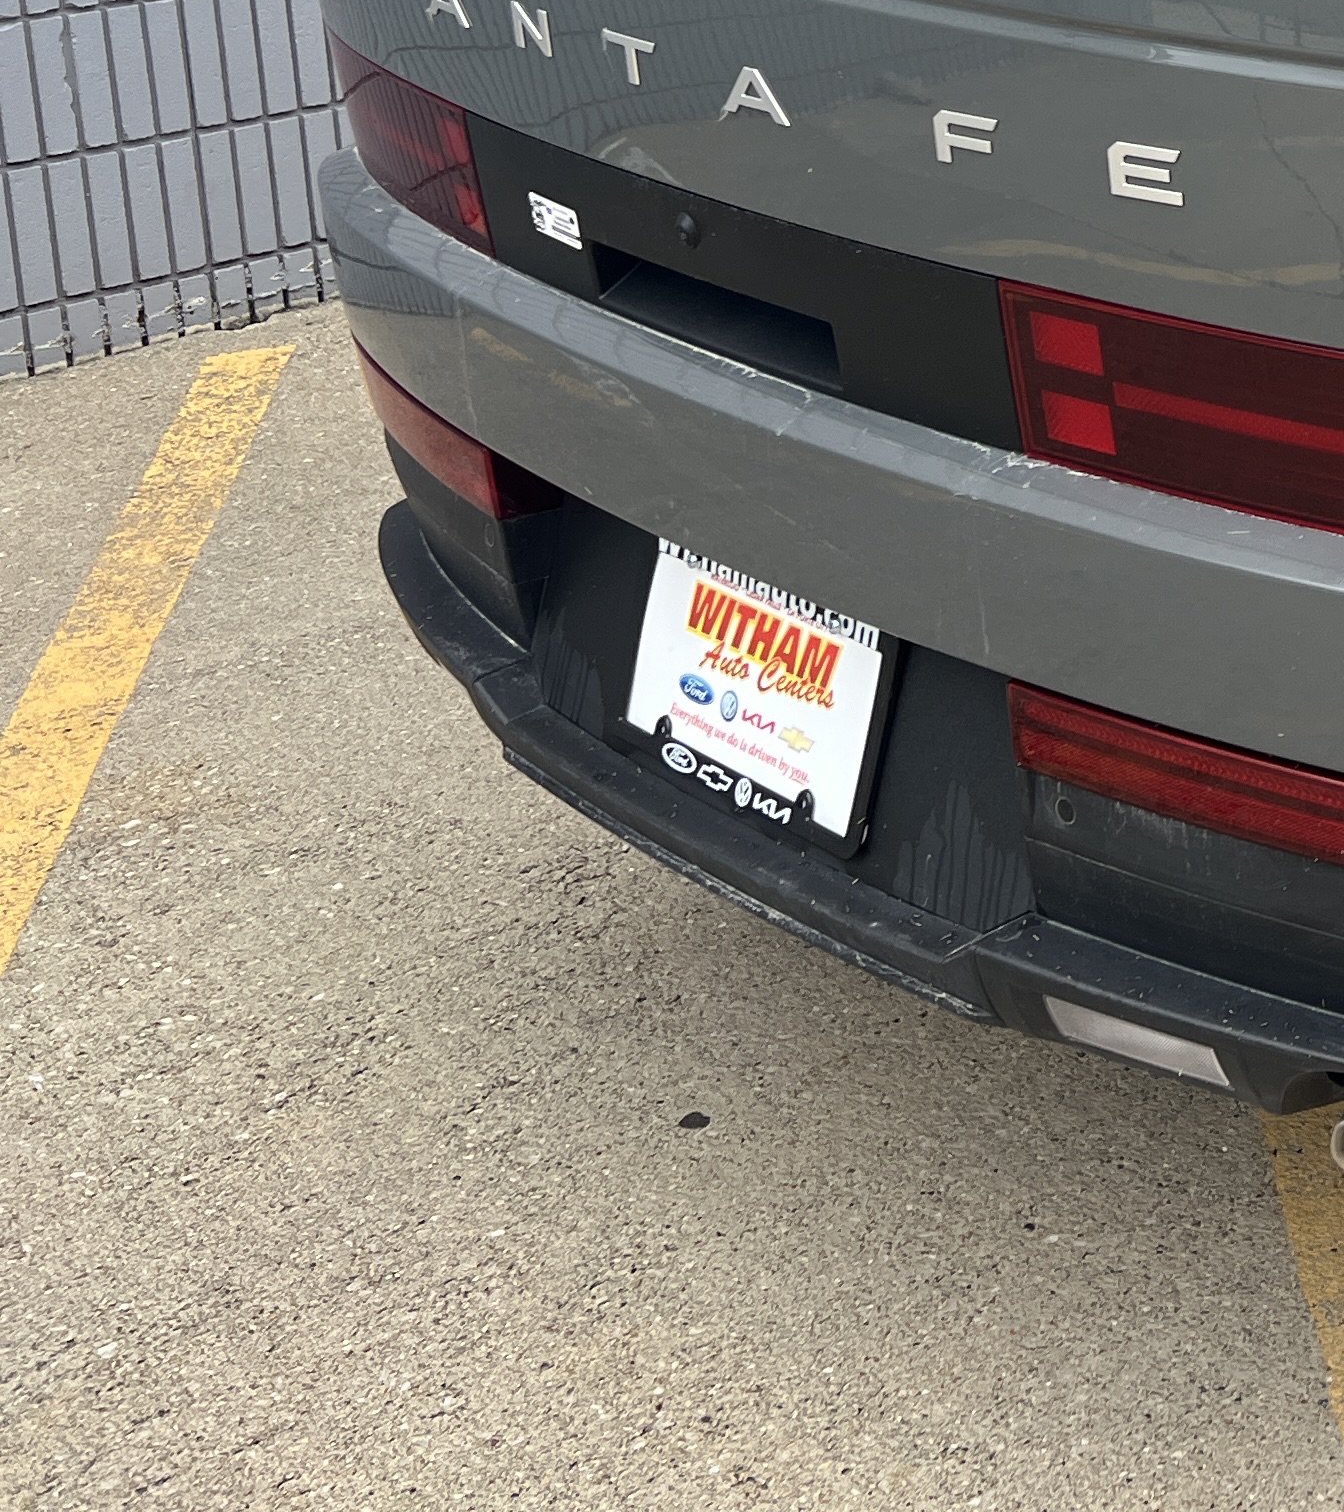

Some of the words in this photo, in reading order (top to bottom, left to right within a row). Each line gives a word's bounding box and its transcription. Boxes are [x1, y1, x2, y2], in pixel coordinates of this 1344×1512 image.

[932, 108, 1186, 208] FE
[687, 581, 842, 689] WITHAM
[682, 676, 711, 703] Ford
[699, 641, 750, 679] Auto
[757, 656, 835, 709] Centers
[669, 701, 714, 738] Everything
[713, 728, 726, 740] we
[727, 733, 738, 748] do
[739, 737, 748, 752] is
[748, 743, 777, 767] driven
[779, 756, 791, 776] by
